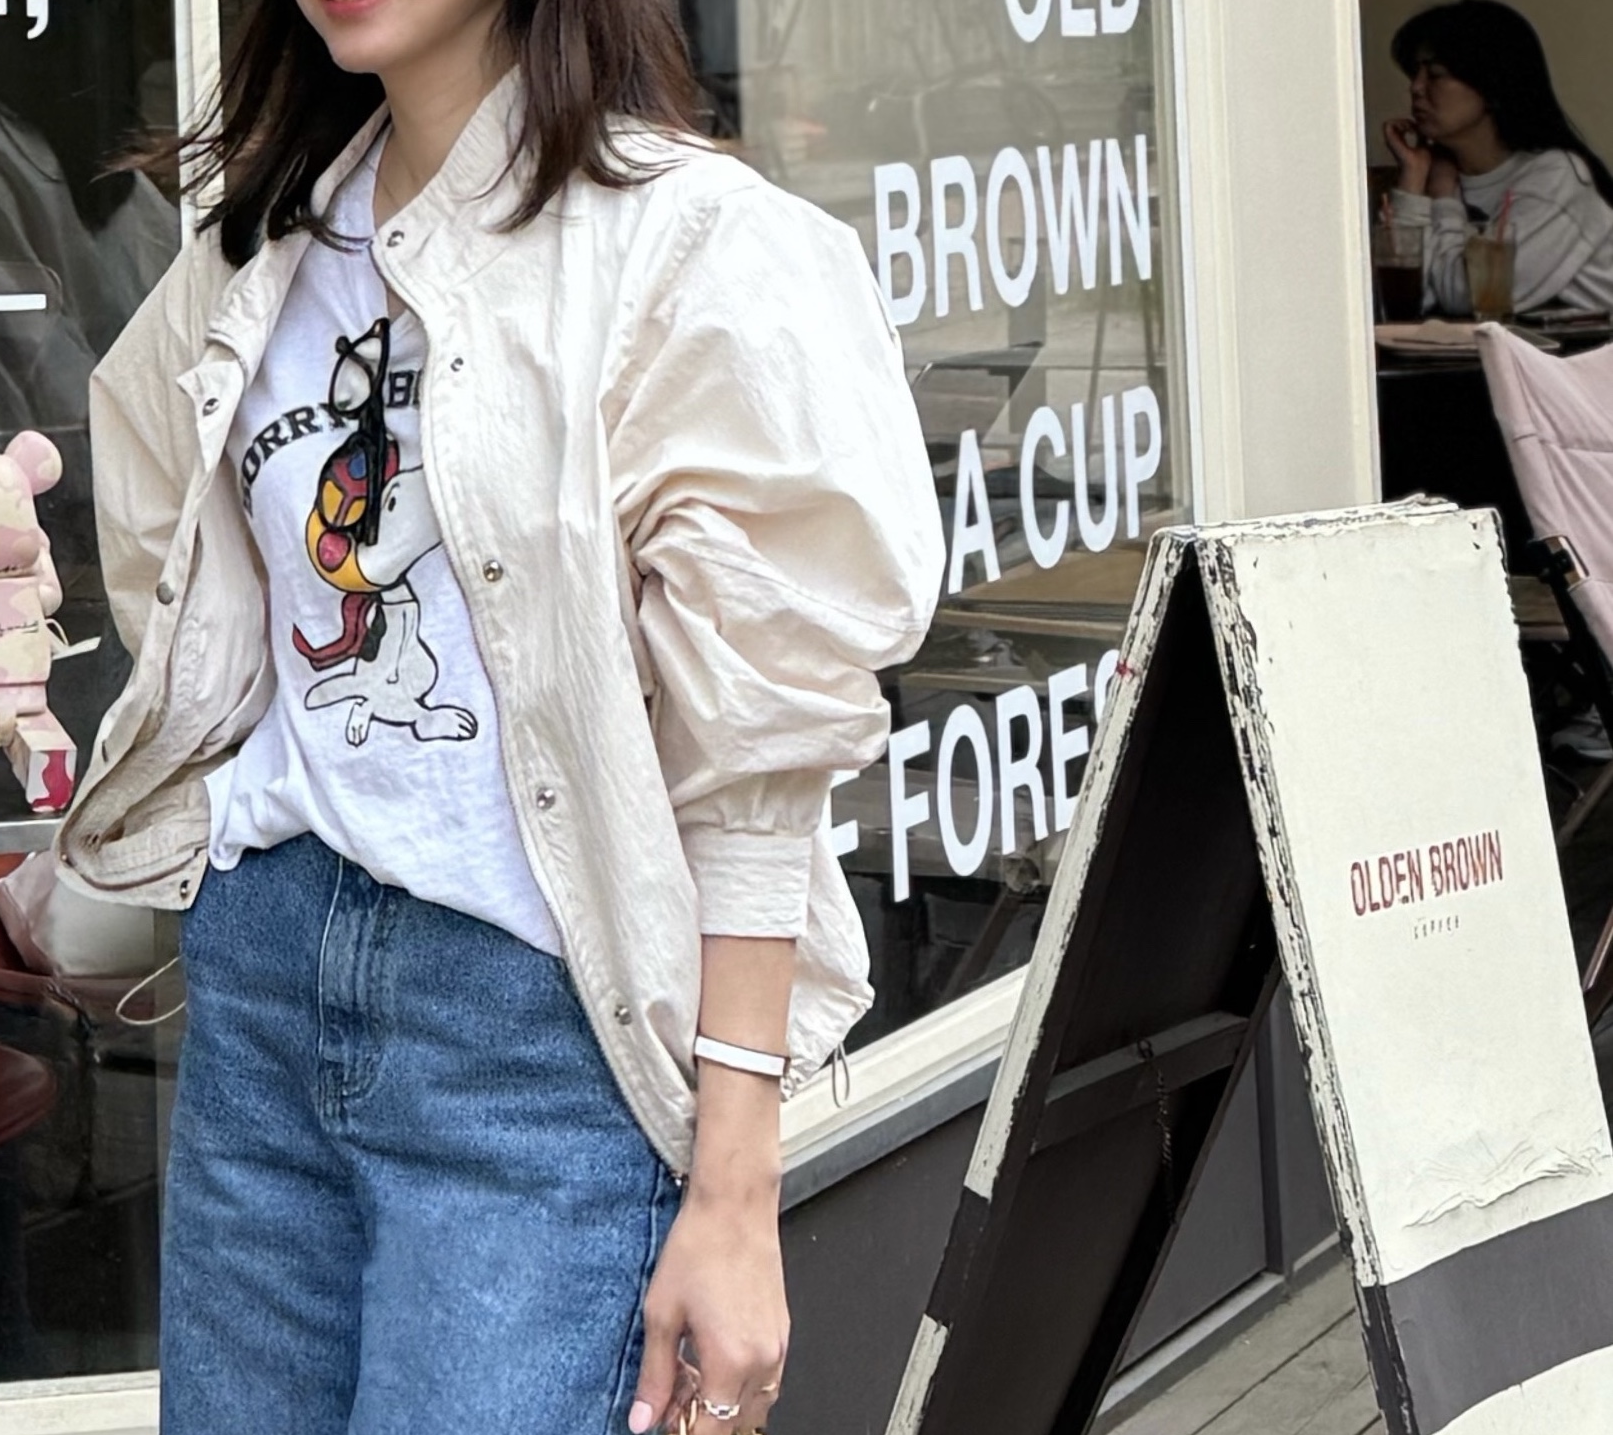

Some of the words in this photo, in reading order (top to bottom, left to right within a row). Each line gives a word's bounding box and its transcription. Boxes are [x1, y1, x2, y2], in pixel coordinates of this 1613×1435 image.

[874, 134, 1152, 326] BROWN
[948, 429, 1002, 594] A
[1019, 386, 1162, 568] CUP
[1350, 848, 1425, 917] OLDEN
[1428, 829, 1504, 898] BROWN
